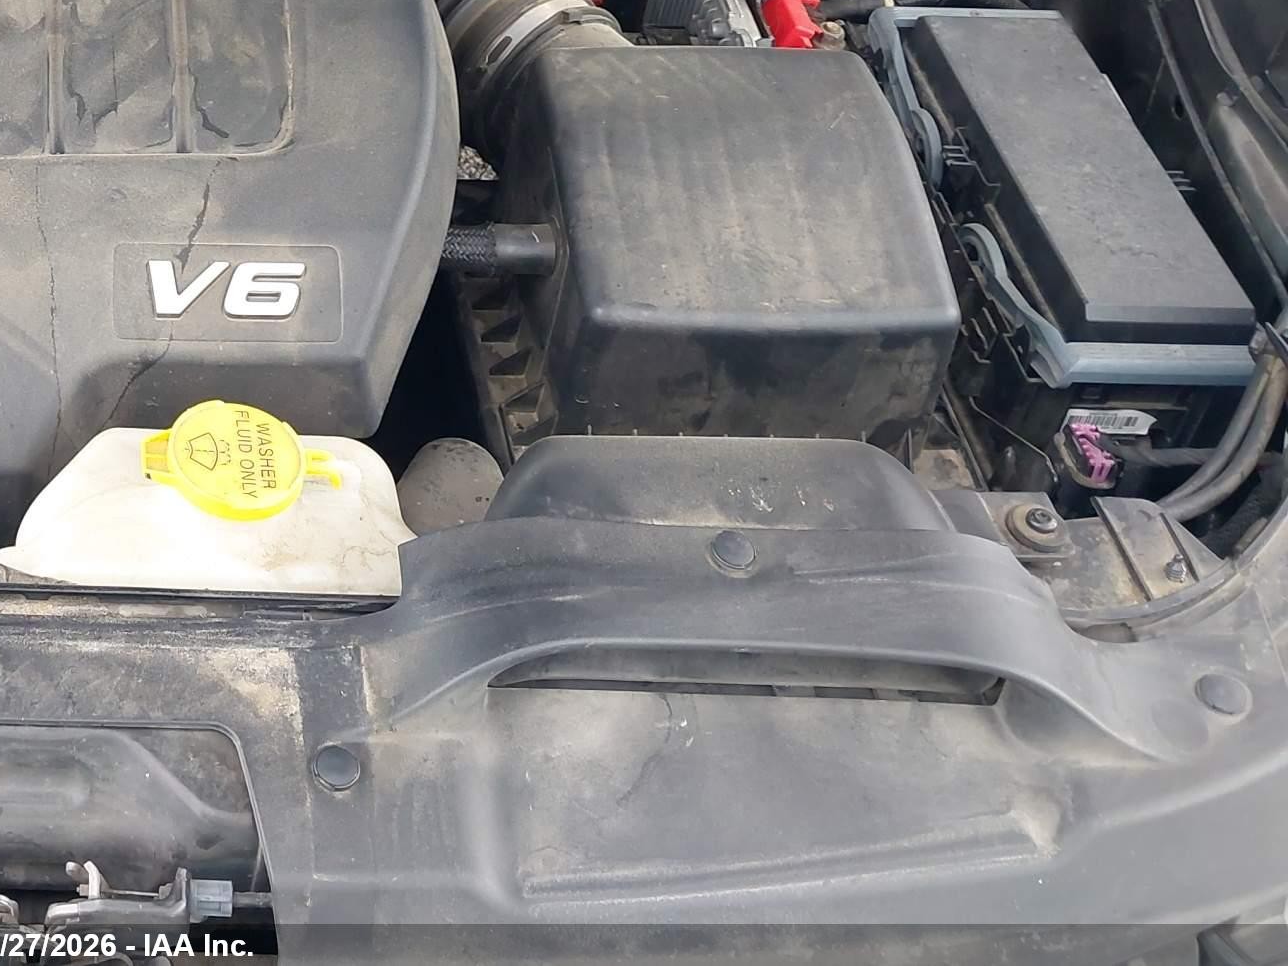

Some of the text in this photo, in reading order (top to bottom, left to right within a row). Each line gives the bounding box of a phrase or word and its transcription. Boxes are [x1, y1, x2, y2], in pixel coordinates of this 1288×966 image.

[148, 259, 307, 319] V6
[234, 410, 260, 499] FLUID ONLY
[255, 422, 278, 489] WASHER
